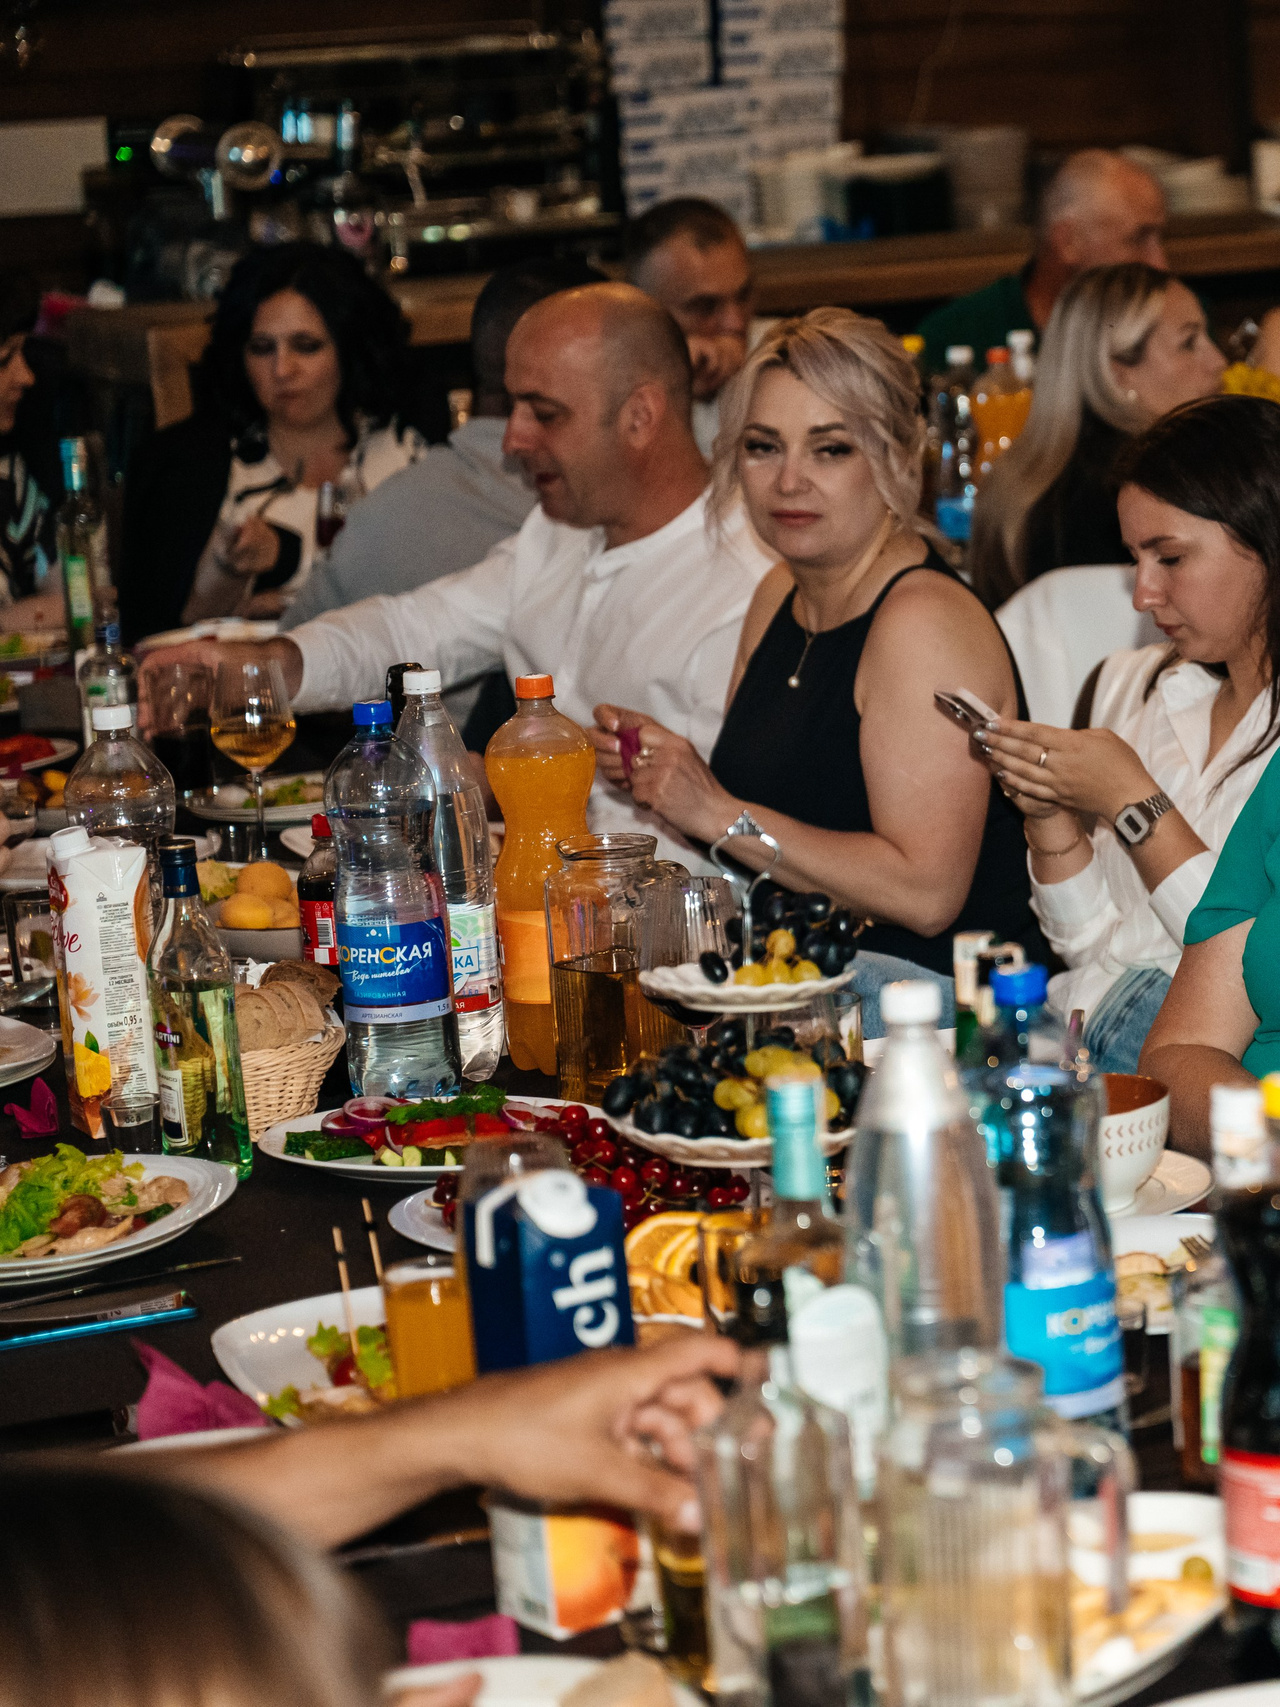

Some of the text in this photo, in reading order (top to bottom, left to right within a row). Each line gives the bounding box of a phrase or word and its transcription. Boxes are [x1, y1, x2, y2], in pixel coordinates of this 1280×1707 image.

[454, 954, 474, 969] КА
[155, 1031, 180, 1044] ARTINI
[551, 1244, 621, 1349] ch
